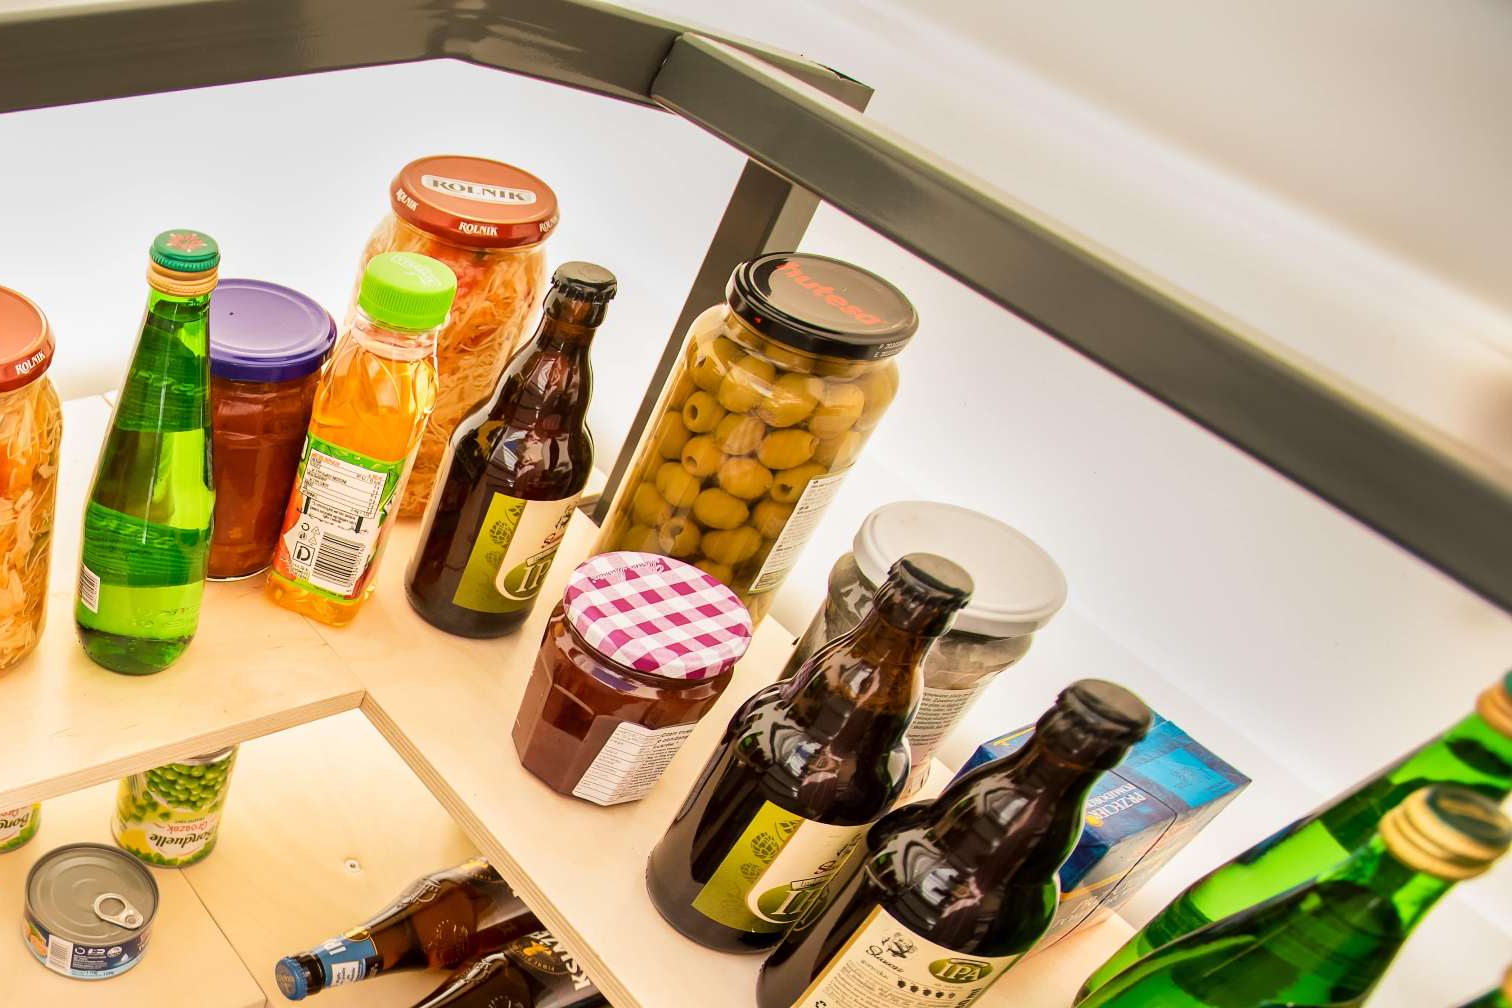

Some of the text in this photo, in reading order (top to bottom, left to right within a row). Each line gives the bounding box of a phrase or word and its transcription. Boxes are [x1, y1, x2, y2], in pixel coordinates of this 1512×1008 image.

[395, 188, 419, 211] ROLNIK
[432, 179, 526, 201] ROLNIK
[459, 222, 499, 236] ROLNIK
[15, 350, 46, 375] ROLNIK
[514, 559, 554, 593] IP
[936, 963, 982, 982] IPA
